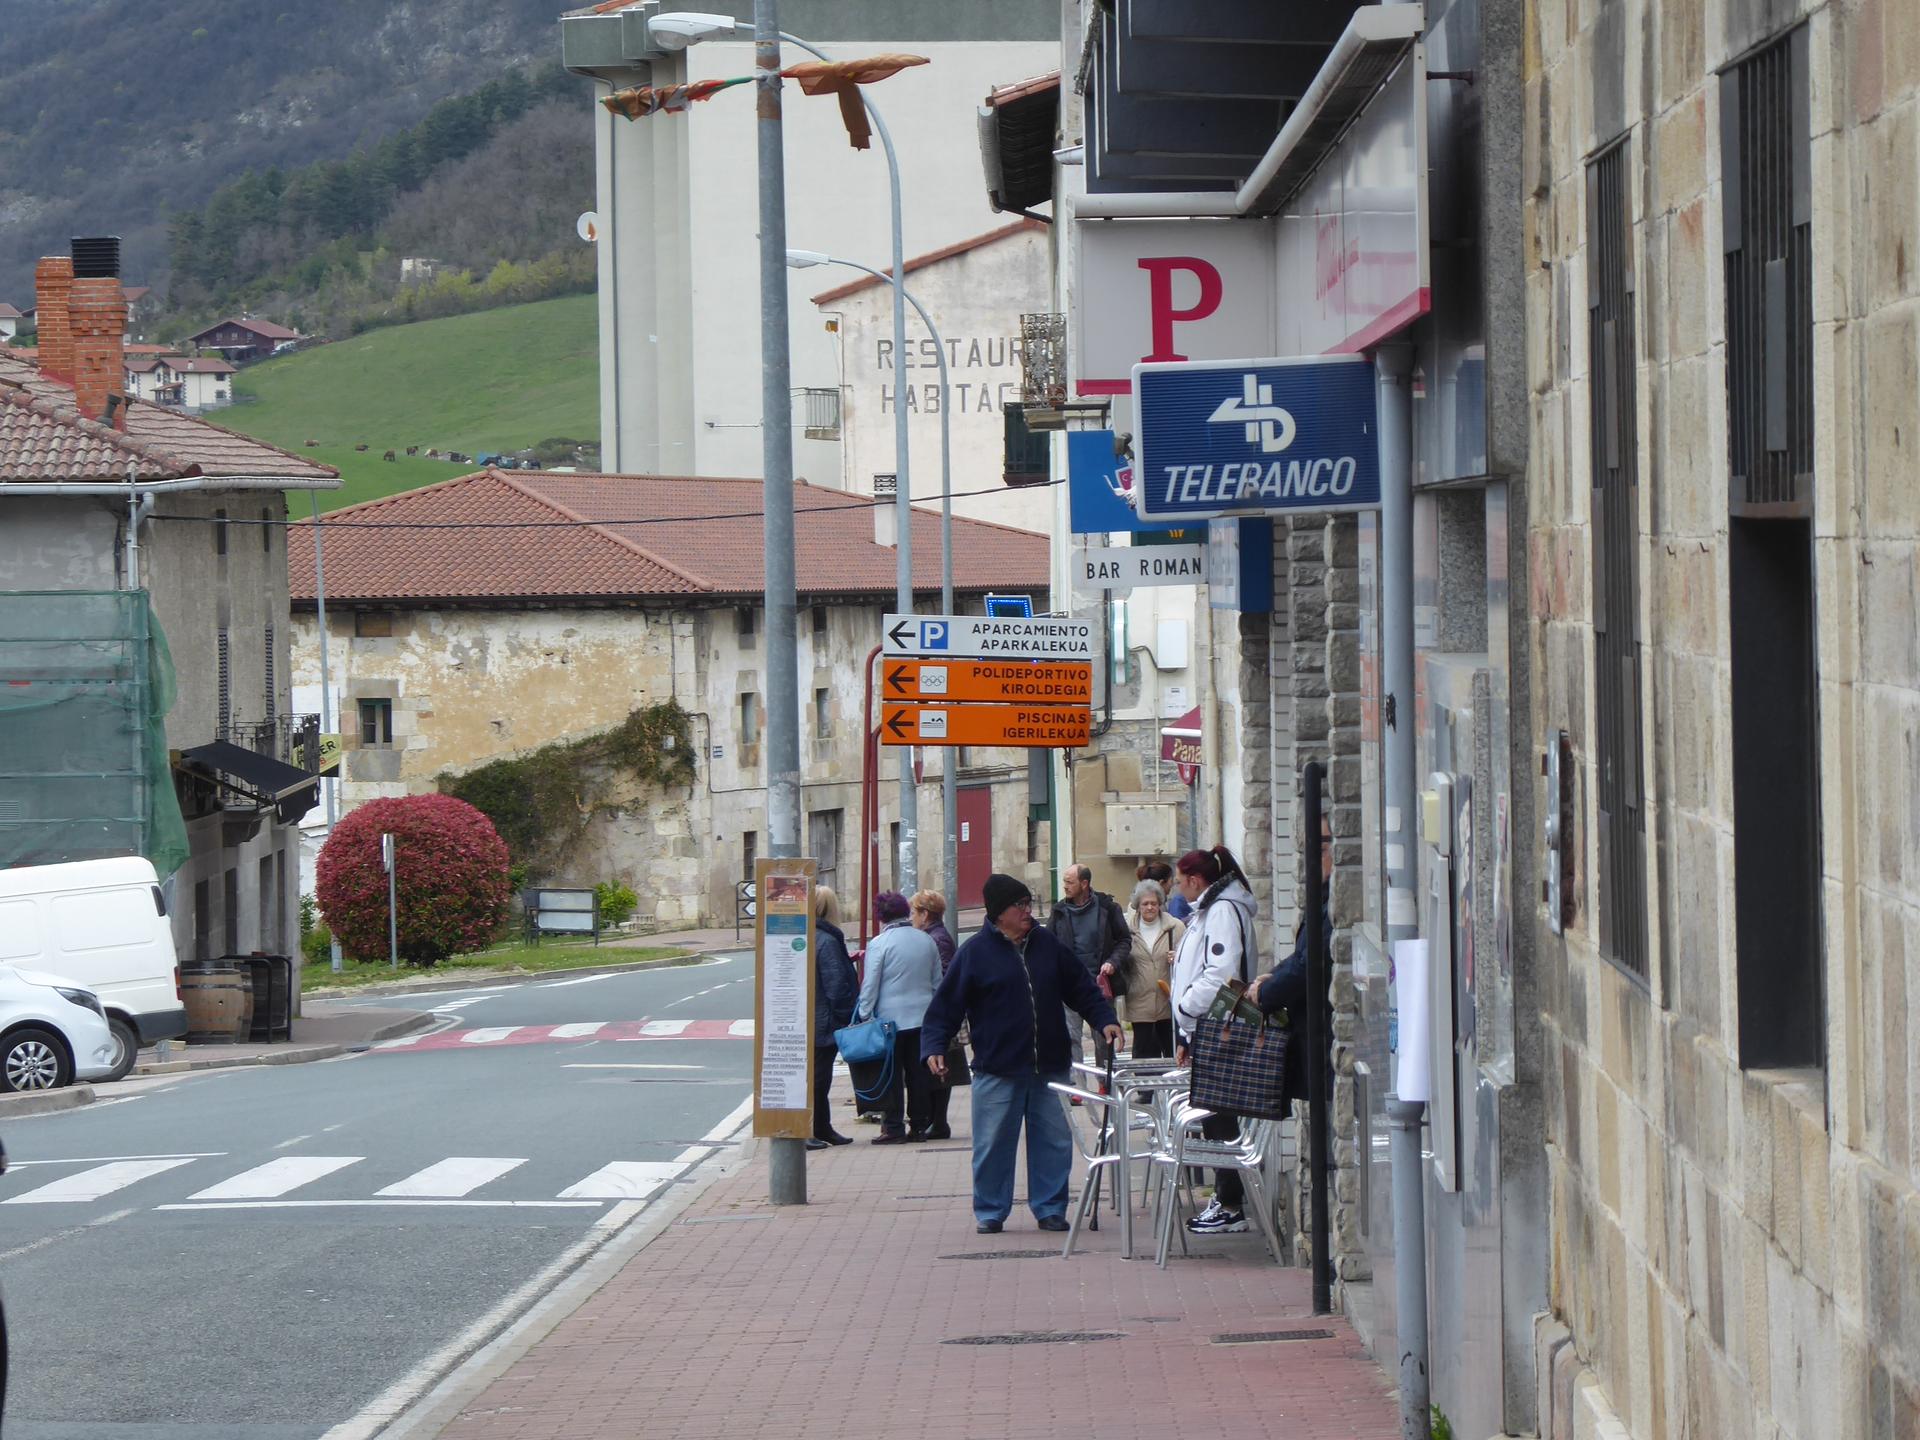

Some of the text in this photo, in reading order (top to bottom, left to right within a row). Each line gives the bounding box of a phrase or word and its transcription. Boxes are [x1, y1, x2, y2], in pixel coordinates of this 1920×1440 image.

[1137, 256, 1223, 362] P
[1163, 456, 1357, 503] TELEBANCO
[1086, 557, 1202, 580] BAR ROMAN
[923, 622, 1089, 647] P APARCAMIENTO
[980, 639, 1089, 652] APARKALEKUA
[973, 667, 1089, 680] POLIDEPORTIVO
[1001, 683, 1088, 696] KIROLDEGIA
[1018, 712, 1087, 724] PISCINAS
[1003, 727, 1087, 739] IGERILEKUA
